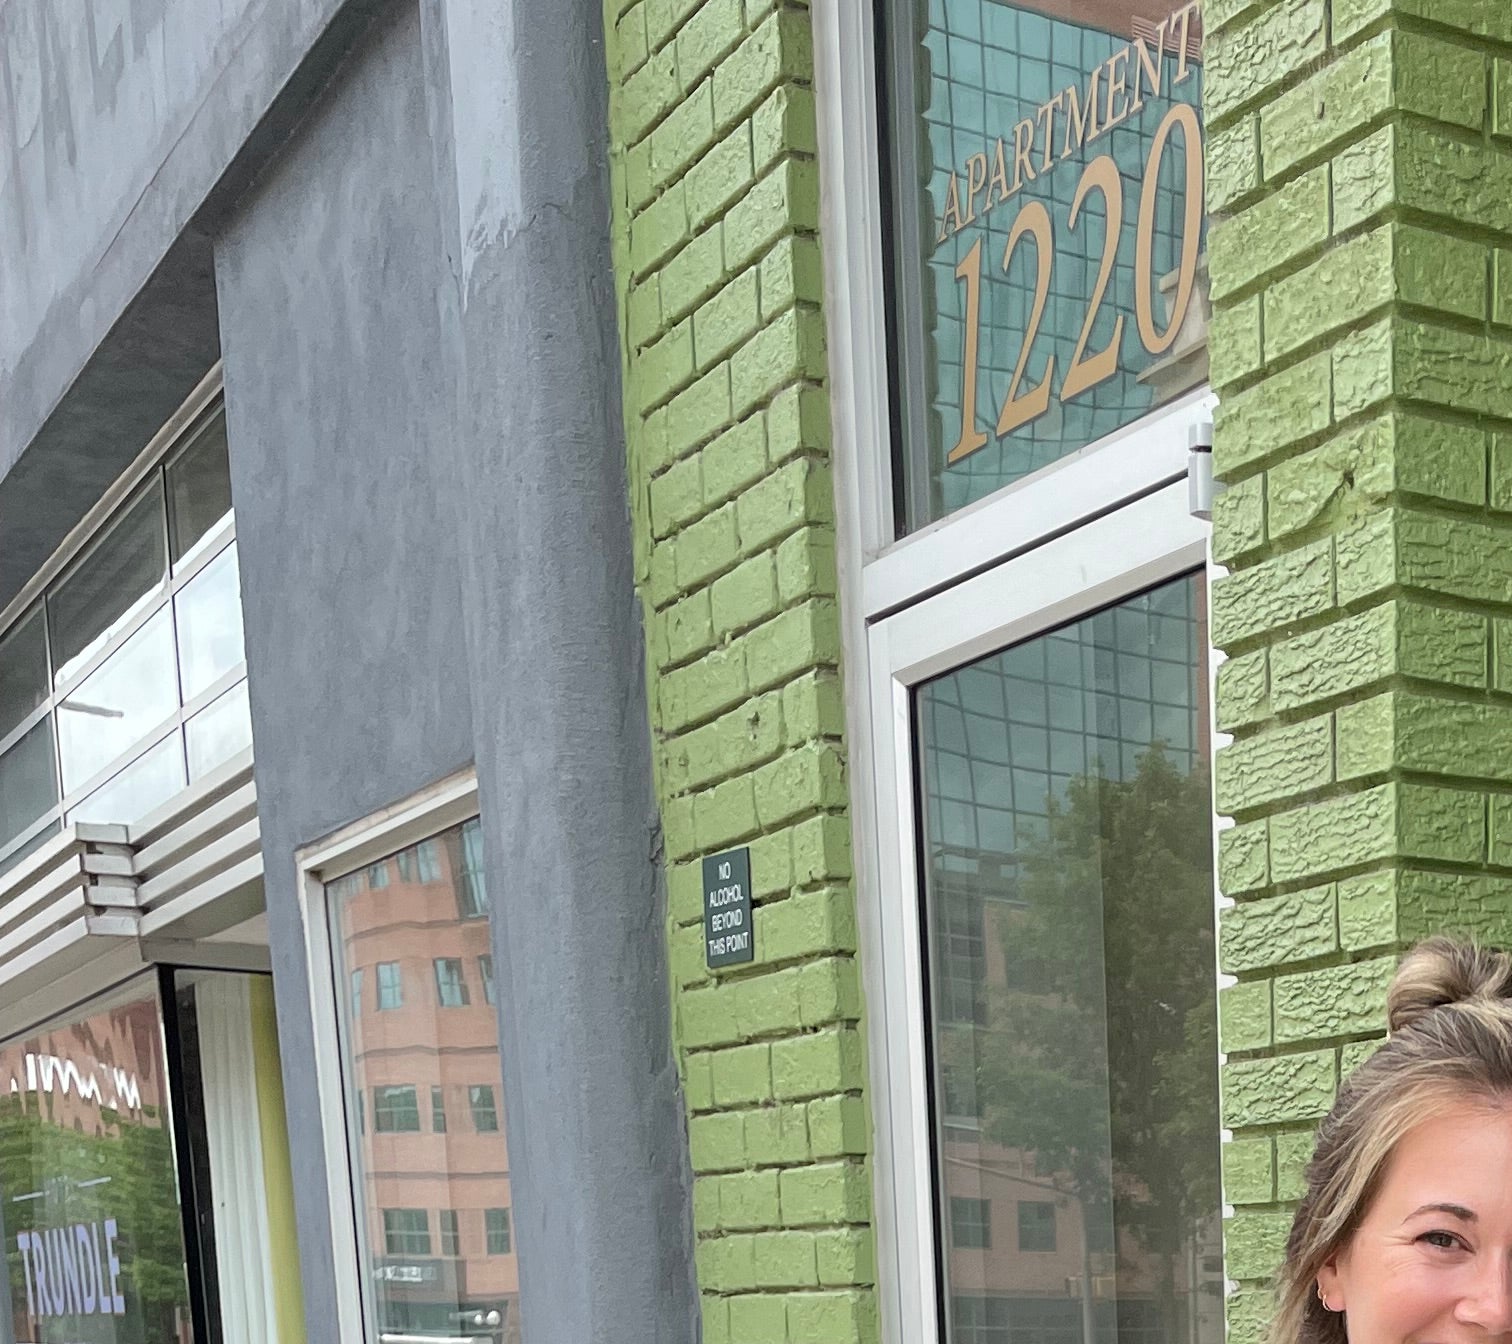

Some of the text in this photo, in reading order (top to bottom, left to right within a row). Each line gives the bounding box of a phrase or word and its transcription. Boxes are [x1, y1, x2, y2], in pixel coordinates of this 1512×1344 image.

[936, 0, 1204, 243] APARTMENT
[947, 104, 1206, 468] 1220
[719, 861, 731, 879] NO
[709, 884, 744, 908] ALCOHOL
[711, 909, 743, 932] BEYOND
[708, 932, 749, 956] THIS POINT
[17, 1218, 126, 1317] TRUNDLE
